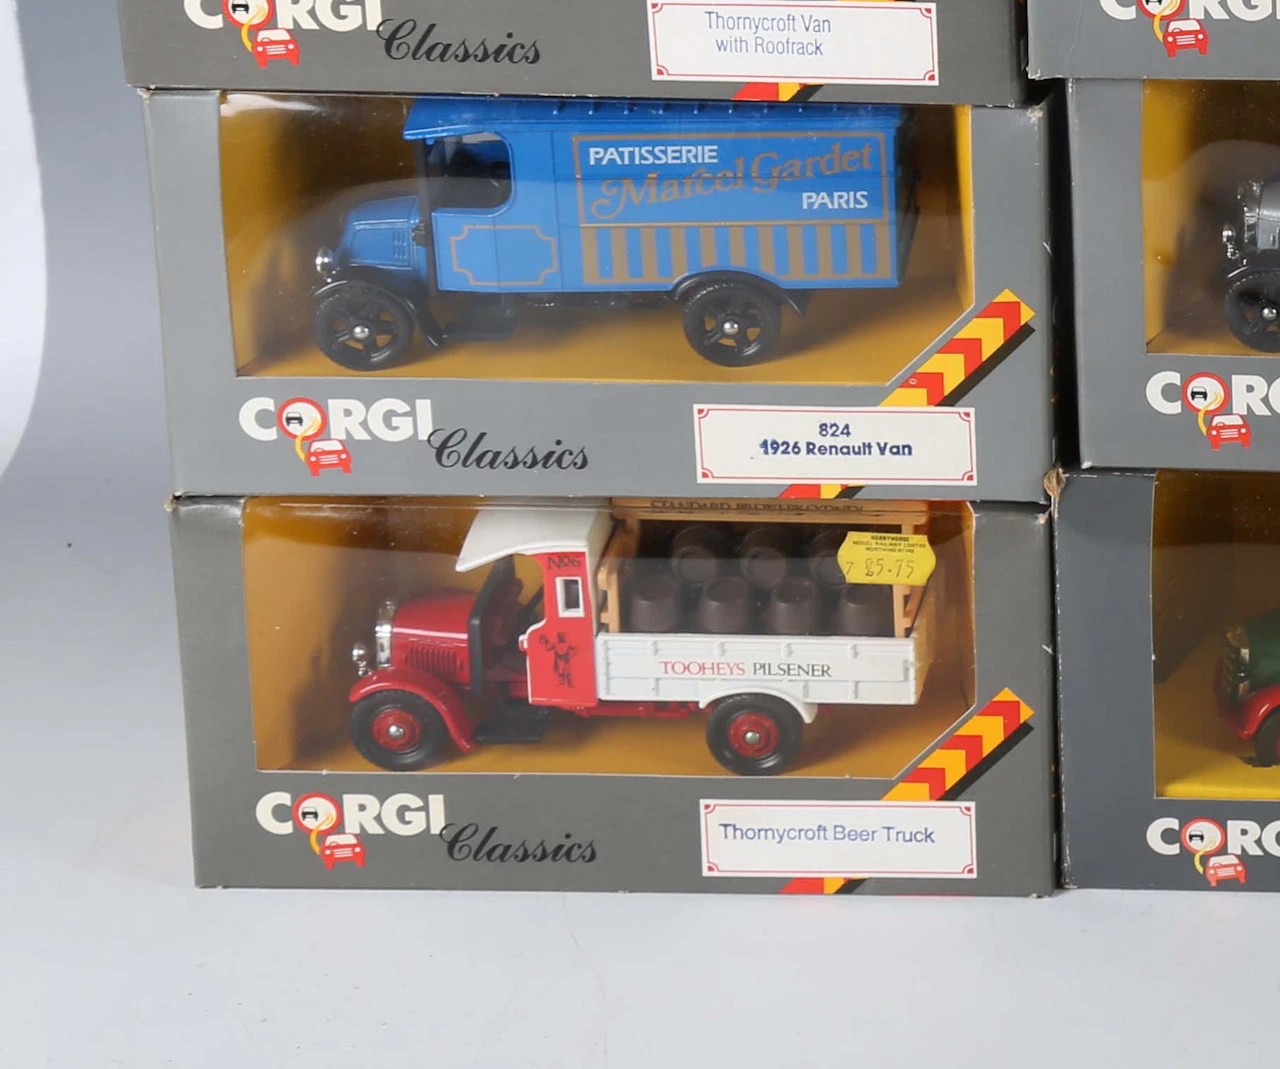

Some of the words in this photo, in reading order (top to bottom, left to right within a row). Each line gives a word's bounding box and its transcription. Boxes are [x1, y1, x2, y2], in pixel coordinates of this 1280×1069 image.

[704, 10, 797, 37] Thornycroft
[800, 14, 832, 34] Van
[376, 18, 542, 65] Classics
[714, 35, 751, 55] with
[754, 36, 824, 57] Roofrack
[589, 145, 719, 166] PATISSERIE
[750, 141, 874, 193] Gardet
[802, 191, 868, 210] PARIS
[238, 397, 433, 442] CORGI
[818, 422, 853, 440] 824
[426, 427, 590, 471] Classics
[759, 439, 803, 458] 1926
[805, 439, 873, 458] Renault
[875, 440, 914, 459] Van
[659, 660, 746, 676] TOOHEYS
[753, 663, 832, 678] PILSENER
[255, 791, 445, 835] CORGI
[439, 823, 596, 865] Classics
[719, 823, 829, 846] Thornycroft
[833, 825, 879, 843] Beer
[882, 826, 936, 844] Truck
